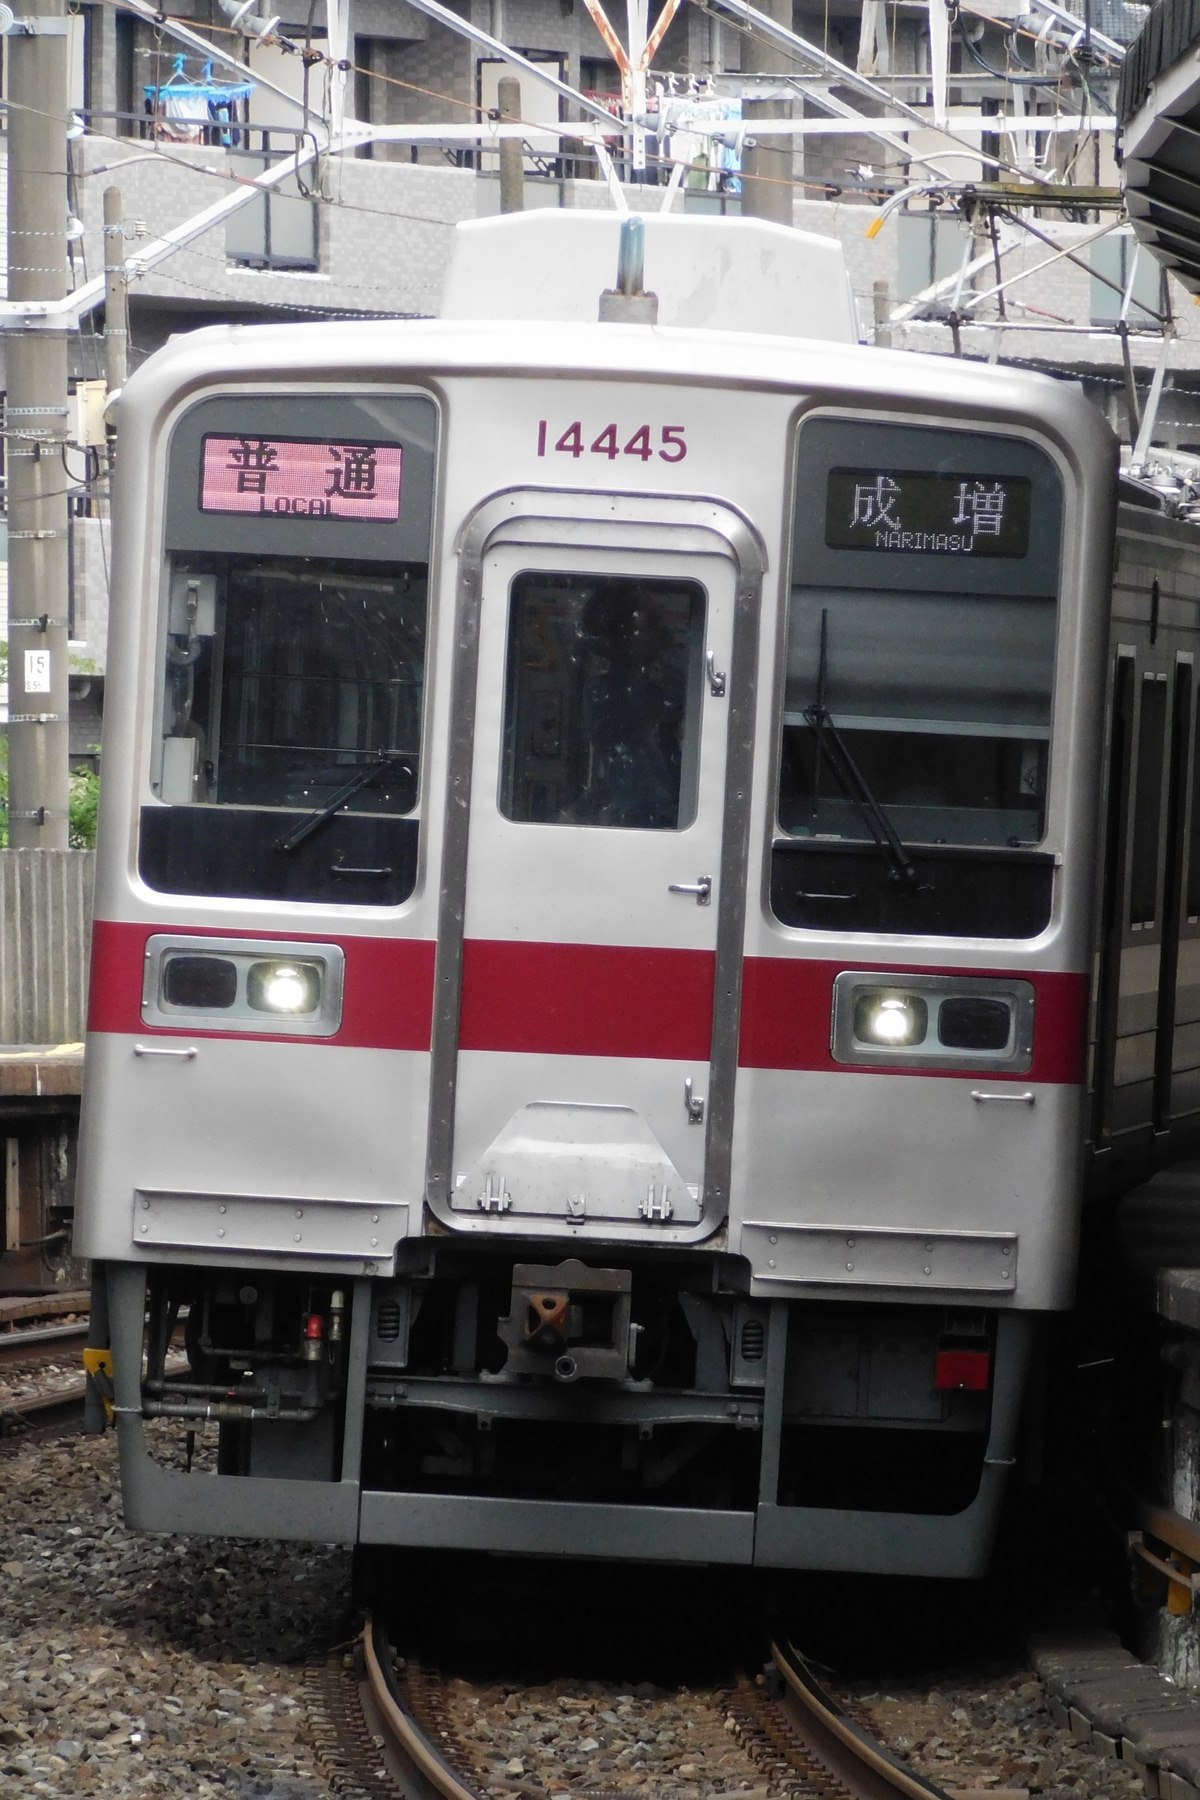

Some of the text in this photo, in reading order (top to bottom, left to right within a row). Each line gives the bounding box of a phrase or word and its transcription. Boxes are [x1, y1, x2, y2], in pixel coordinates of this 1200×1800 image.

[537, 419, 688, 463] 14445
[225, 439, 378, 500] 普通
[260, 496, 339, 517] LOCAL
[850, 476, 1006, 535] 成増
[874, 530, 974, 551] NARIMASU
[29, 655, 46, 674] 15
